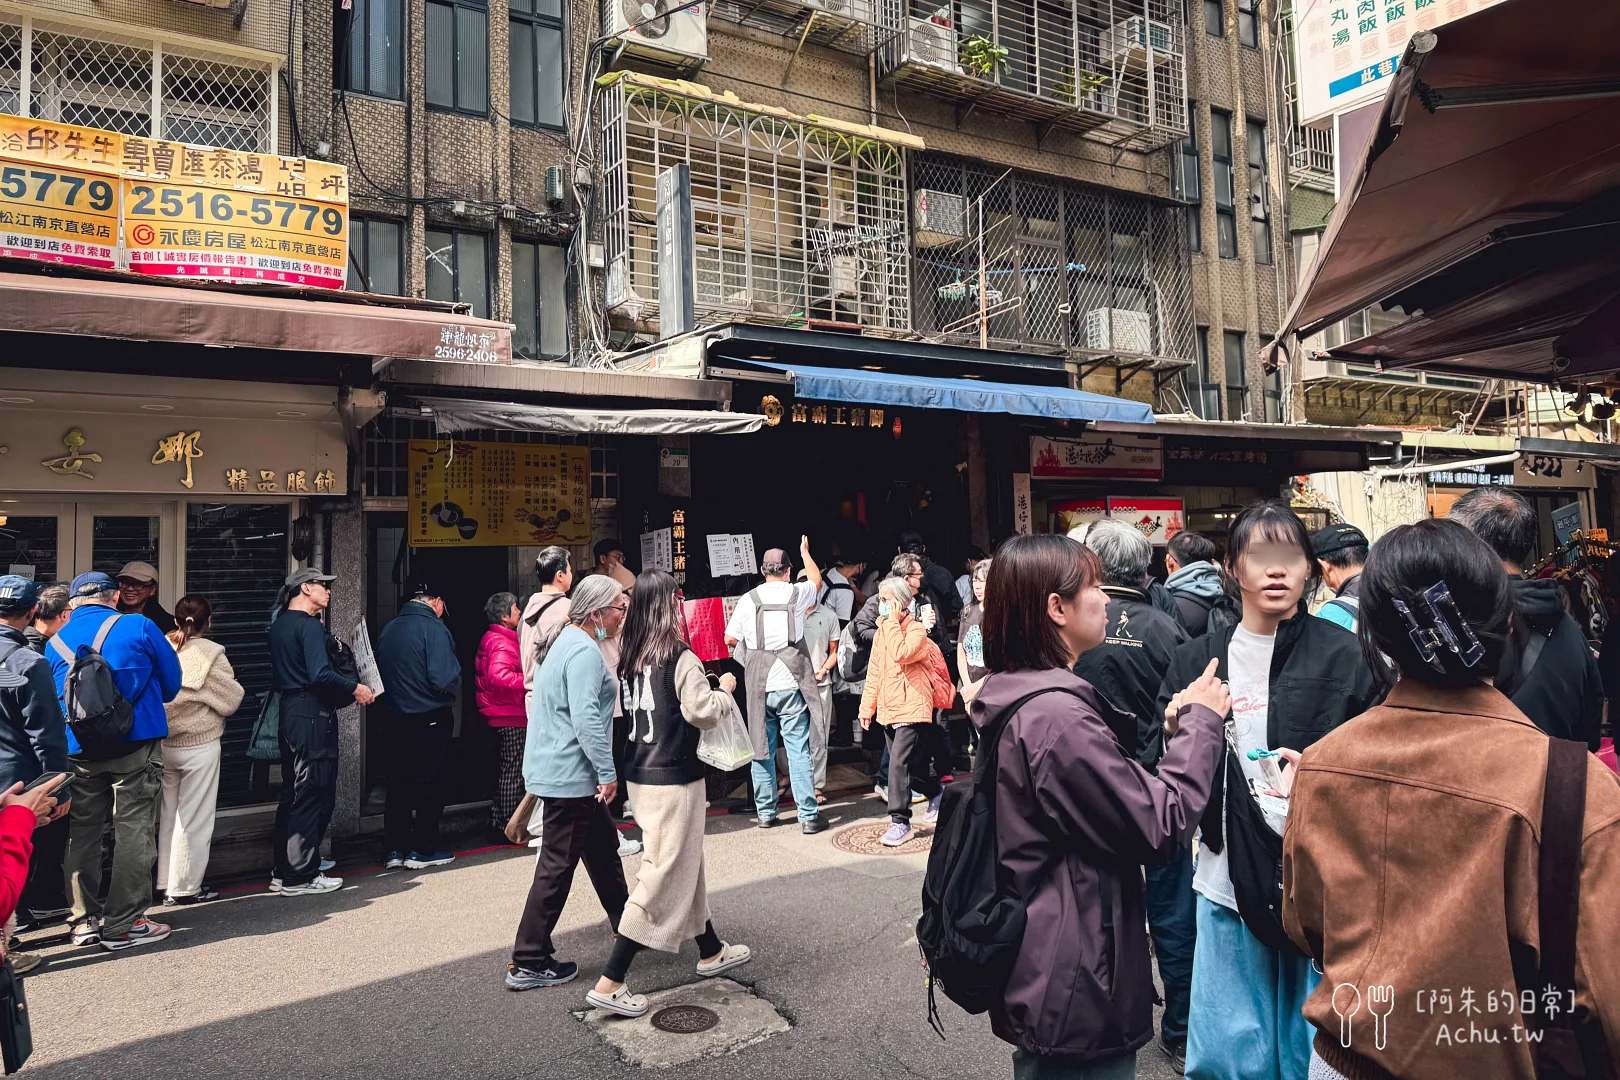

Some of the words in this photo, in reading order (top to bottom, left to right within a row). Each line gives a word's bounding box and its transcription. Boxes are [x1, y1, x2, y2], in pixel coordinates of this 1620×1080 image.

[1329, 0, 1351, 49] 丸湯
[2, 126, 115, 166] 洽邱先生
[0, 210, 111, 239] 松江南京直營店
[131, 186, 343, 236] 2516-5779
[159, 228, 247, 251] 永慶房屋
[250, 236, 341, 261] 松江南京直營店
[791, 403, 885, 429] 富霸王豬腳
[225, 467, 337, 493] 精品服飾
